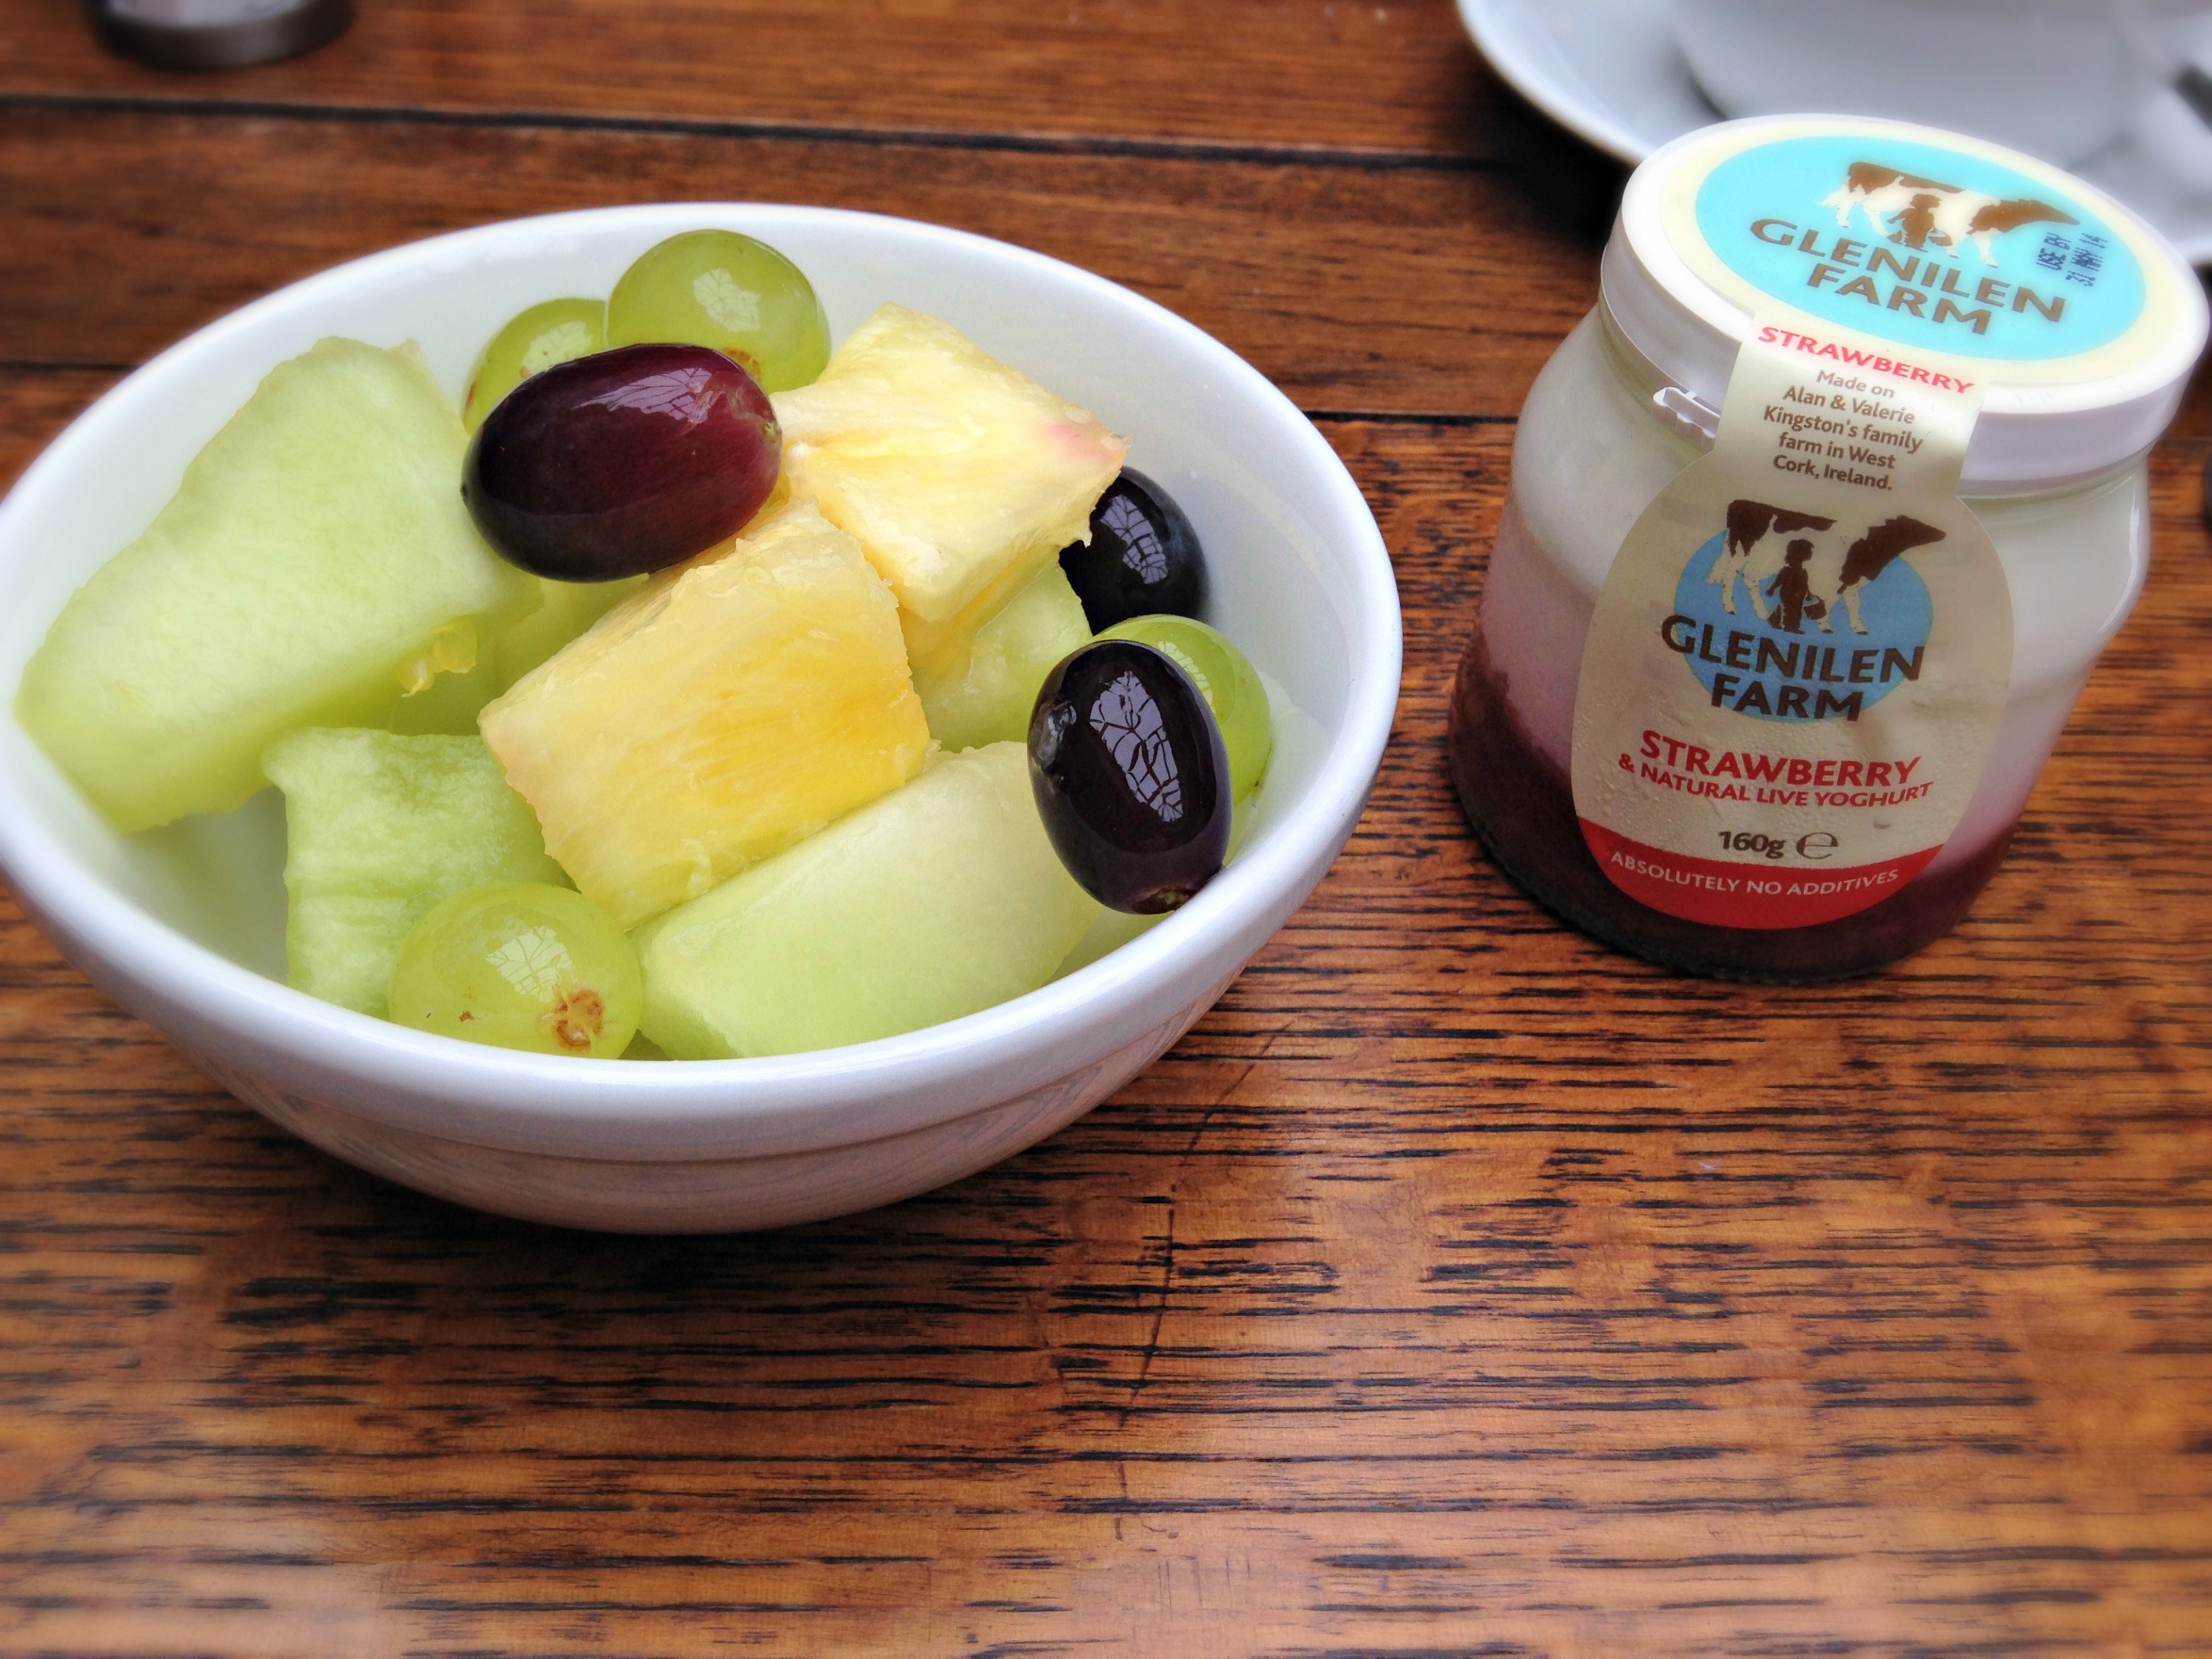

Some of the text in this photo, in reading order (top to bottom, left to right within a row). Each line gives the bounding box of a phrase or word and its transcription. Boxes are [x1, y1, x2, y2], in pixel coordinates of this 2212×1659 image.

[1750, 218, 2066, 323] GLENILEN
[2036, 232, 2071, 271] USE BY
[1807, 262, 1993, 335] FARM
[1758, 326, 1975, 394] STRAWBERRY
[1817, 369, 1895, 398] Made on
[1763, 404, 1923, 453] Kingston's family
[1782, 385, 1915, 424] Alan & Valerie
[1773, 455, 1892, 491] Cork, Ireland.
[1779, 432, 1897, 469] farm in West
[1661, 615, 1924, 683] GLENILEN
[1711, 674, 1863, 722] FARM
[1618, 753, 1934, 807] & NATURAL LIVE YOGHURT
[1640, 729, 1922, 787] STRAWBERRY
[1718, 830, 1786, 859] 160g
[1610, 851, 1899, 896] ABSOLUTELY NO ADDITIVES
